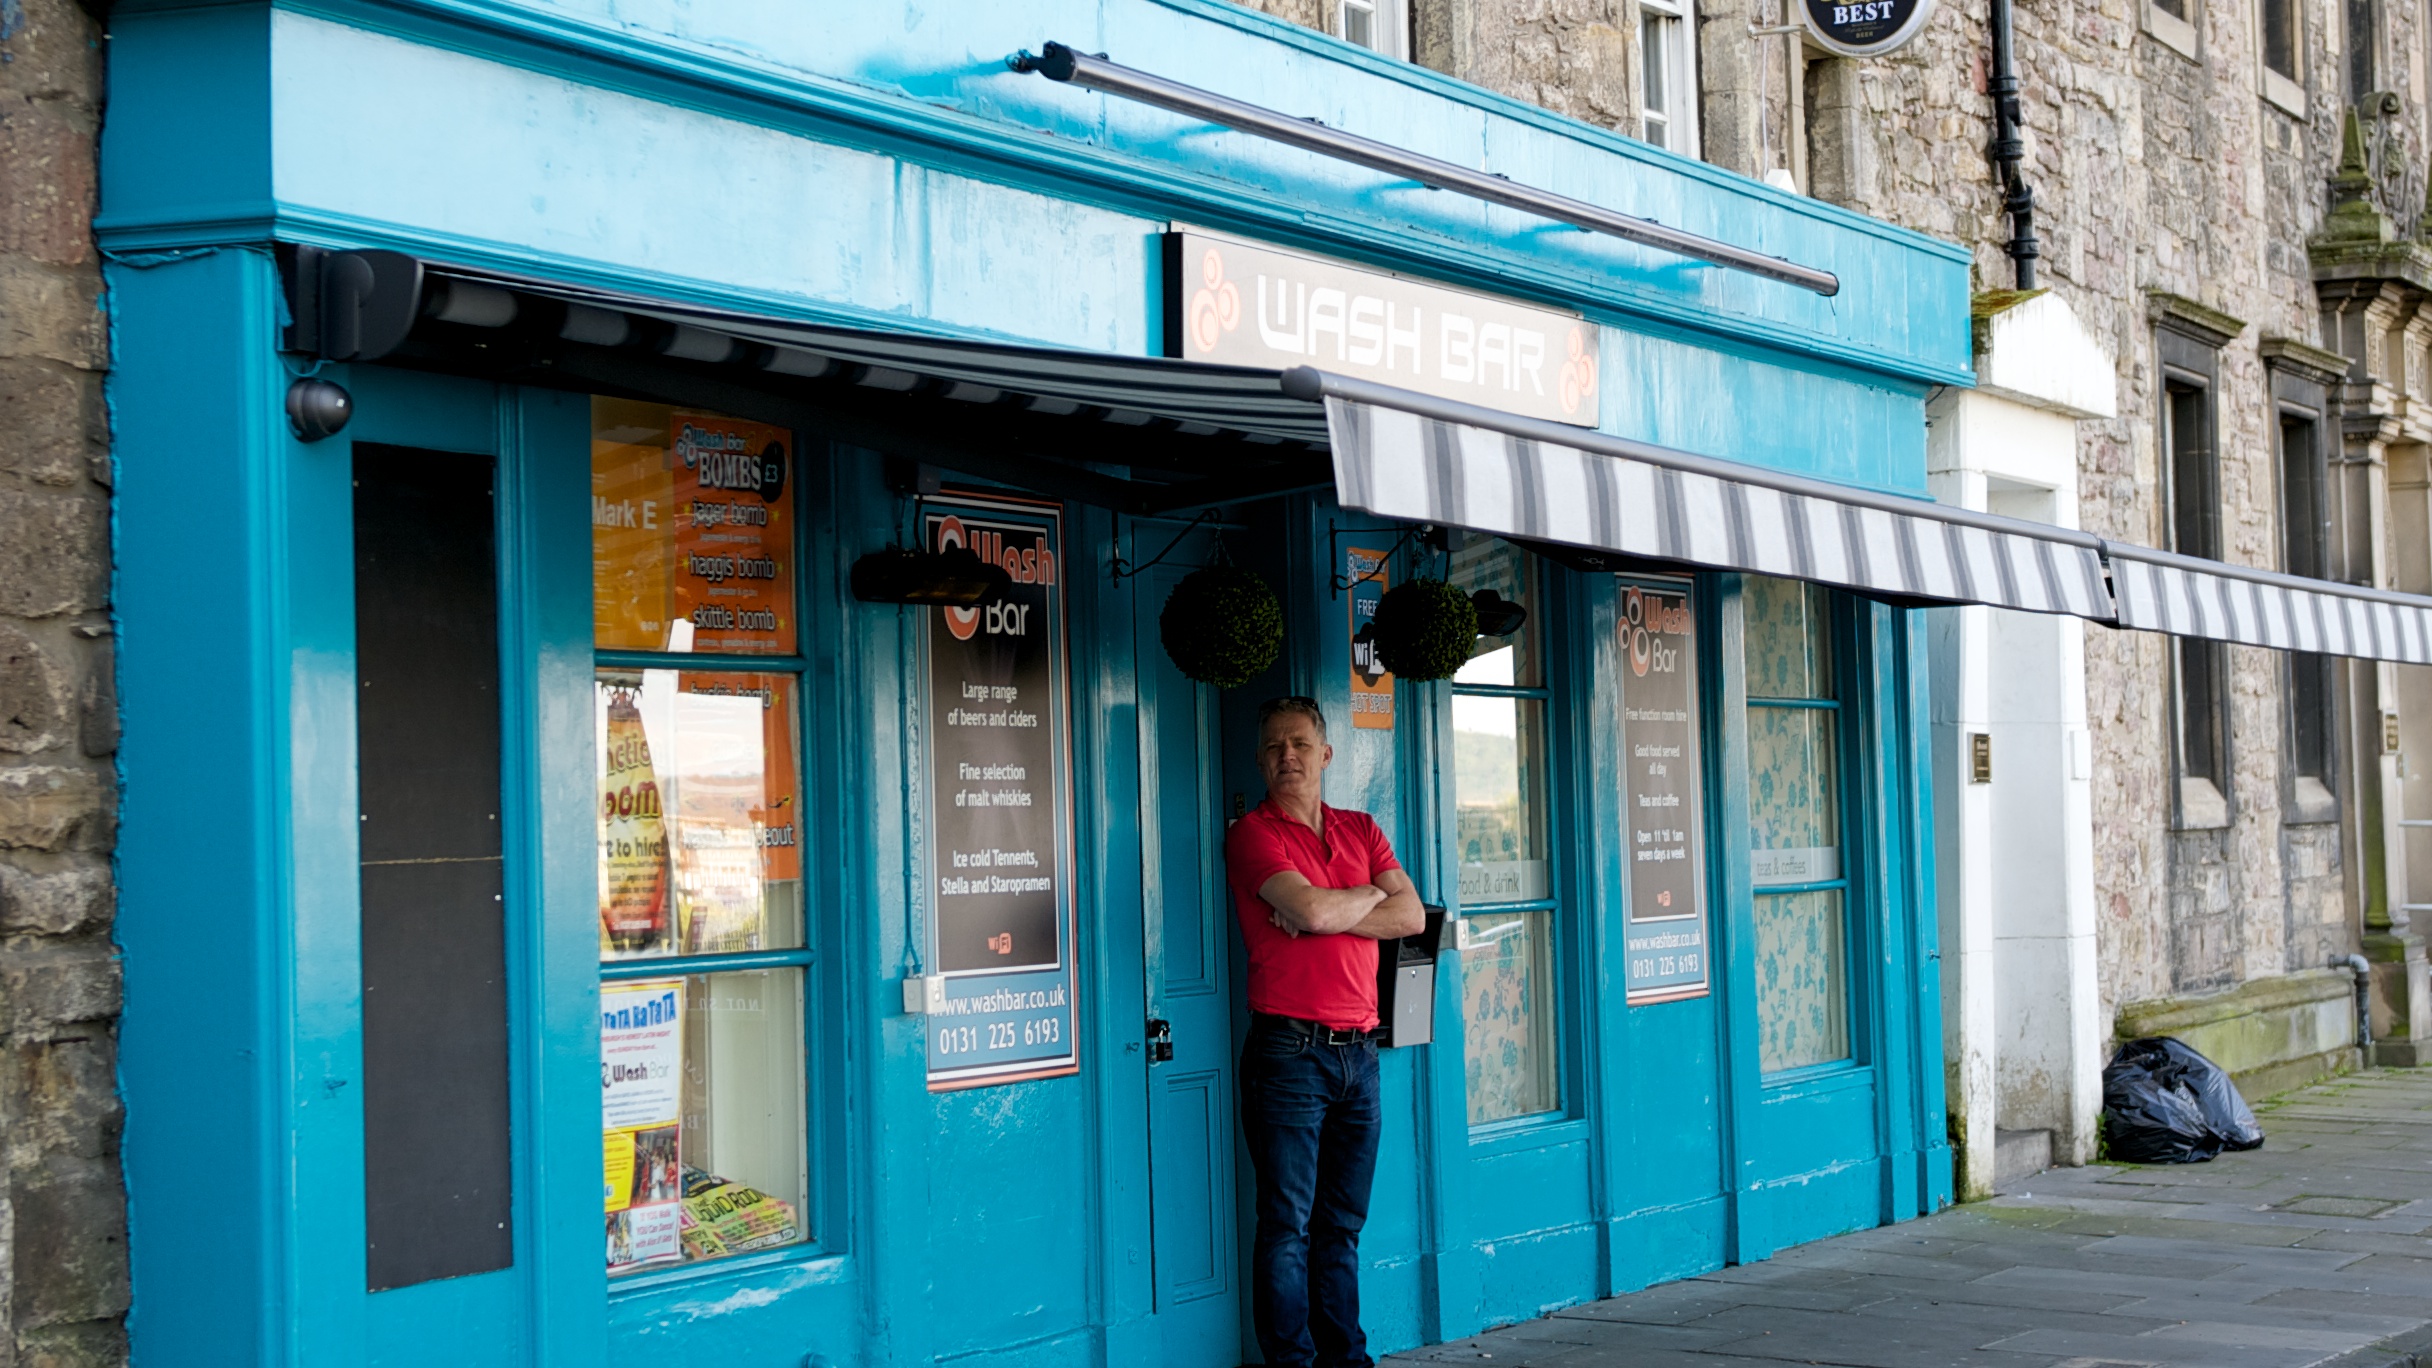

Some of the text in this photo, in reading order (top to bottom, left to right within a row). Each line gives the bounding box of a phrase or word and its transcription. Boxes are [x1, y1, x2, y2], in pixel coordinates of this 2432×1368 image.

[1833, 0, 1894, 25] BEST
[1257, 274, 1545, 396] WASH BAR
[698, 452, 761, 491] BOMBS
[592, 495, 657, 530] Mark E
[730, 498, 768, 527] bomb
[689, 550, 775, 582] haggis bomb
[693, 604, 776, 631] skittle bomb
[985, 599, 1030, 636] Bar
[1357, 599, 1378, 617] FREE
[1644, 596, 1691, 636] Wash
[1653, 638, 1677, 673] Bar
[962, 681, 1018, 704] Large range
[948, 708, 1038, 728] of beers and ciders
[1626, 707, 1687, 722] Free function room hire
[1635, 744, 1680, 758] Good food served
[959, 762, 1026, 780] Fine selection
[1656, 761, 1667, 778] day
[603, 780, 659, 820] oom
[955, 789, 1032, 807] of malt whiskies
[1638, 793, 1680, 807] Teas and coffee
[1637, 829, 1652, 846] Open
[1654, 829, 1661, 843] 11
[1672, 829, 1685, 842] 1am
[953, 848, 1039, 868] Ice cold Tennents,
[1637, 846, 1686, 863] seven days a week
[941, 875, 1051, 896] Stella and Staropramen
[1484, 872, 1492, 894] &
[1495, 872, 1520, 894] drink
[1628, 929, 1701, 951] www.washbar.co.uk
[1633, 953, 1698, 979] 0131 225 6193
[935, 983, 1065, 1017] ww.washbar.co.uk
[940, 1017, 1060, 1055] 0131 225 6193
[613, 1061, 648, 1082] Wash
[649, 1061, 670, 1079] Bar
